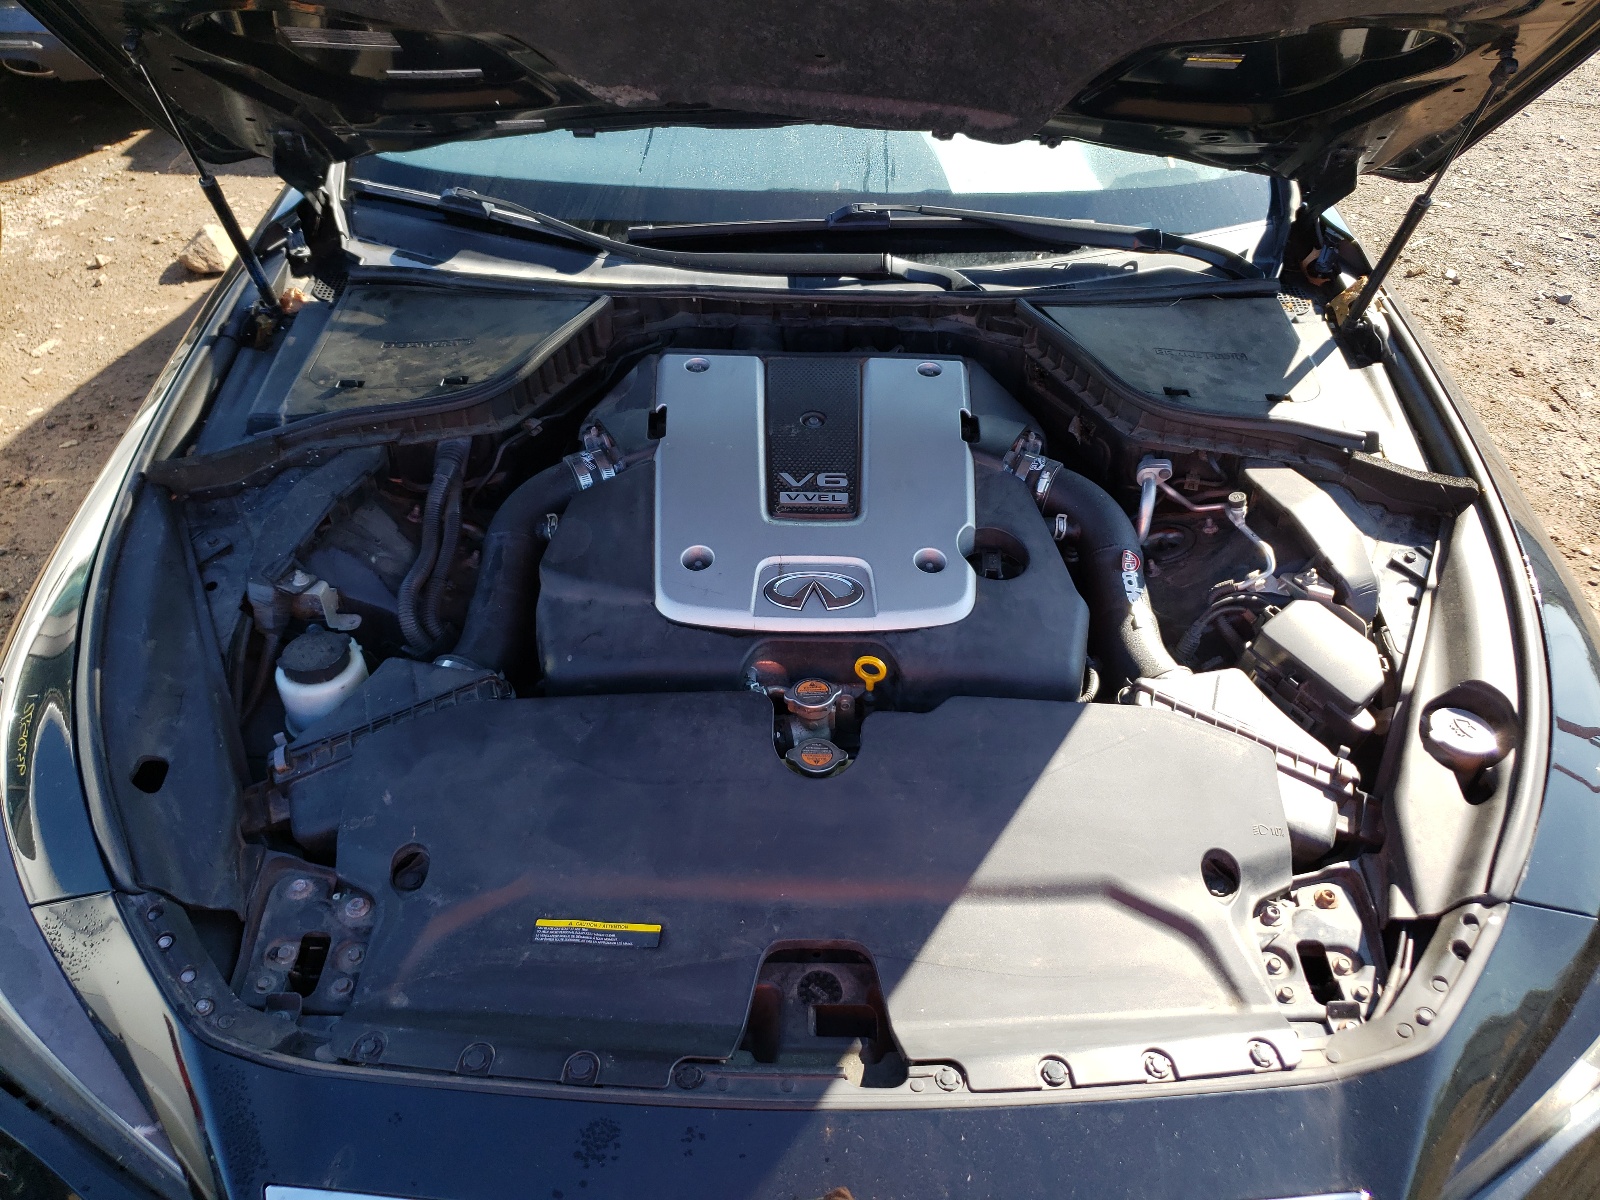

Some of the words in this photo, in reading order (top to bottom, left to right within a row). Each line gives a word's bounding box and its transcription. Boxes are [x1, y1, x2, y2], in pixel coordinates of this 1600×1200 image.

[779, 472, 848, 487] V6
[785, 493, 843, 502] VVEL
[575, 921, 598, 929] CAUTION
[602, 922, 629, 930] ATTENTION
